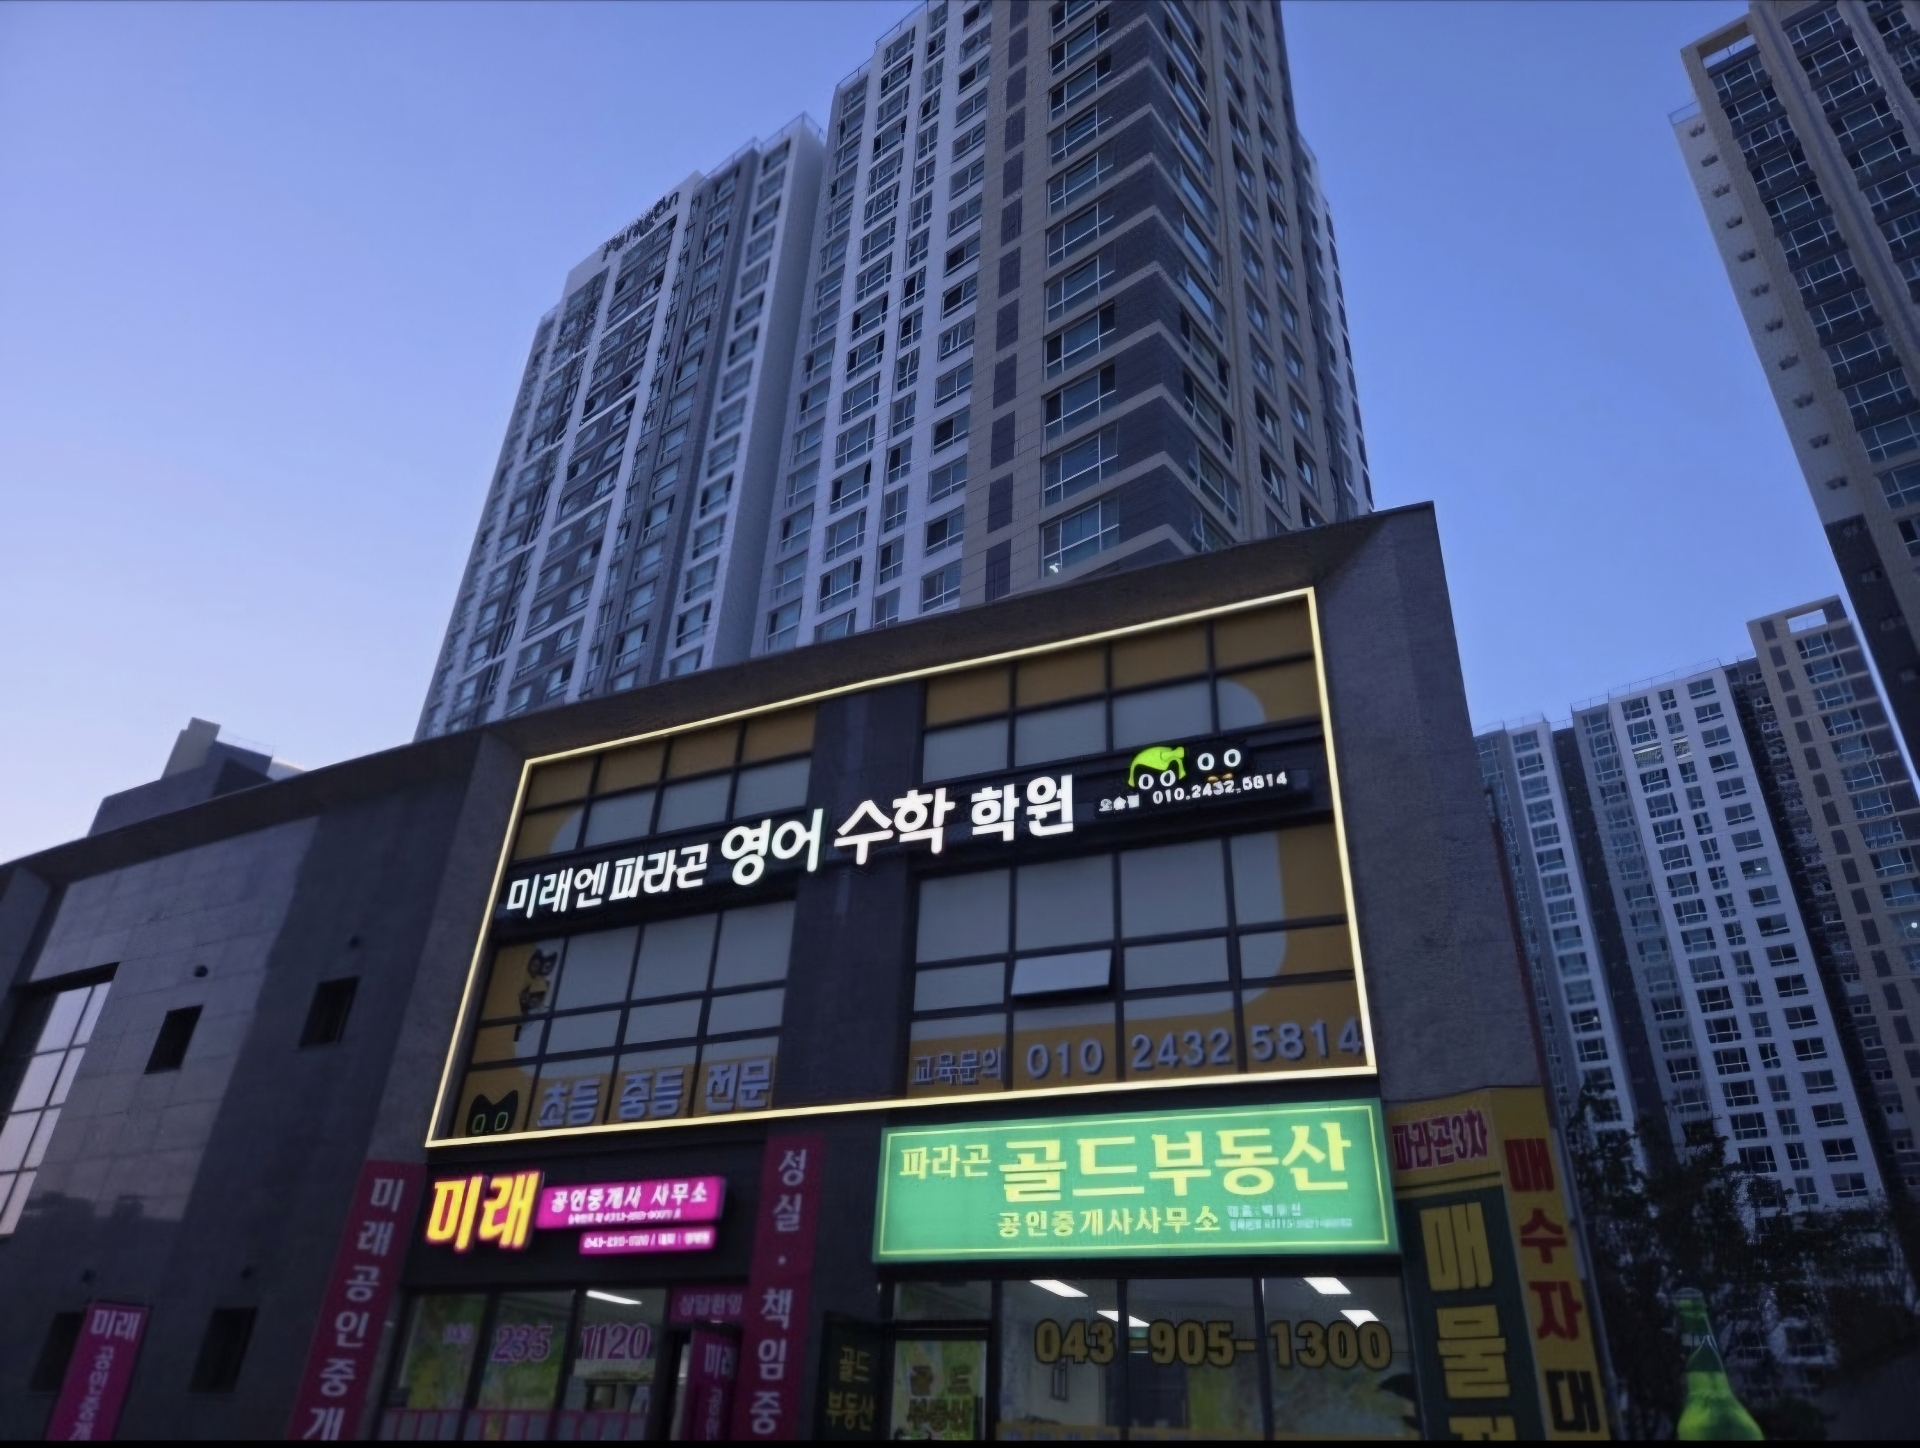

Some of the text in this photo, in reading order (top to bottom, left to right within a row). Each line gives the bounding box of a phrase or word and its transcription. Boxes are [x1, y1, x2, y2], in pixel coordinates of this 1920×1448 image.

[720, 807, 825, 886] 영어
[833, 786, 955, 866] 수학
[970, 773, 1074, 842] 학원
[1026, 1038, 1105, 1079] 010
[1130, 1027, 1232, 1070] 2432
[1250, 1017, 1365, 1062] 5814
[537, 1058, 772, 1128] 초등 중등 전문
[899, 1121, 1353, 1203] 파라곤 골드부동산
[1392, 1108, 1488, 1171] 파라곤3차
[426, 1170, 542, 1252] 미래
[650, 1181, 708, 1207] 사무소
[767, 1149, 808, 1232] 성실
[91, 1309, 141, 1341] 미래
[581, 1322, 651, 1360] 1120
[1419, 1201, 1517, 1441] 매물
